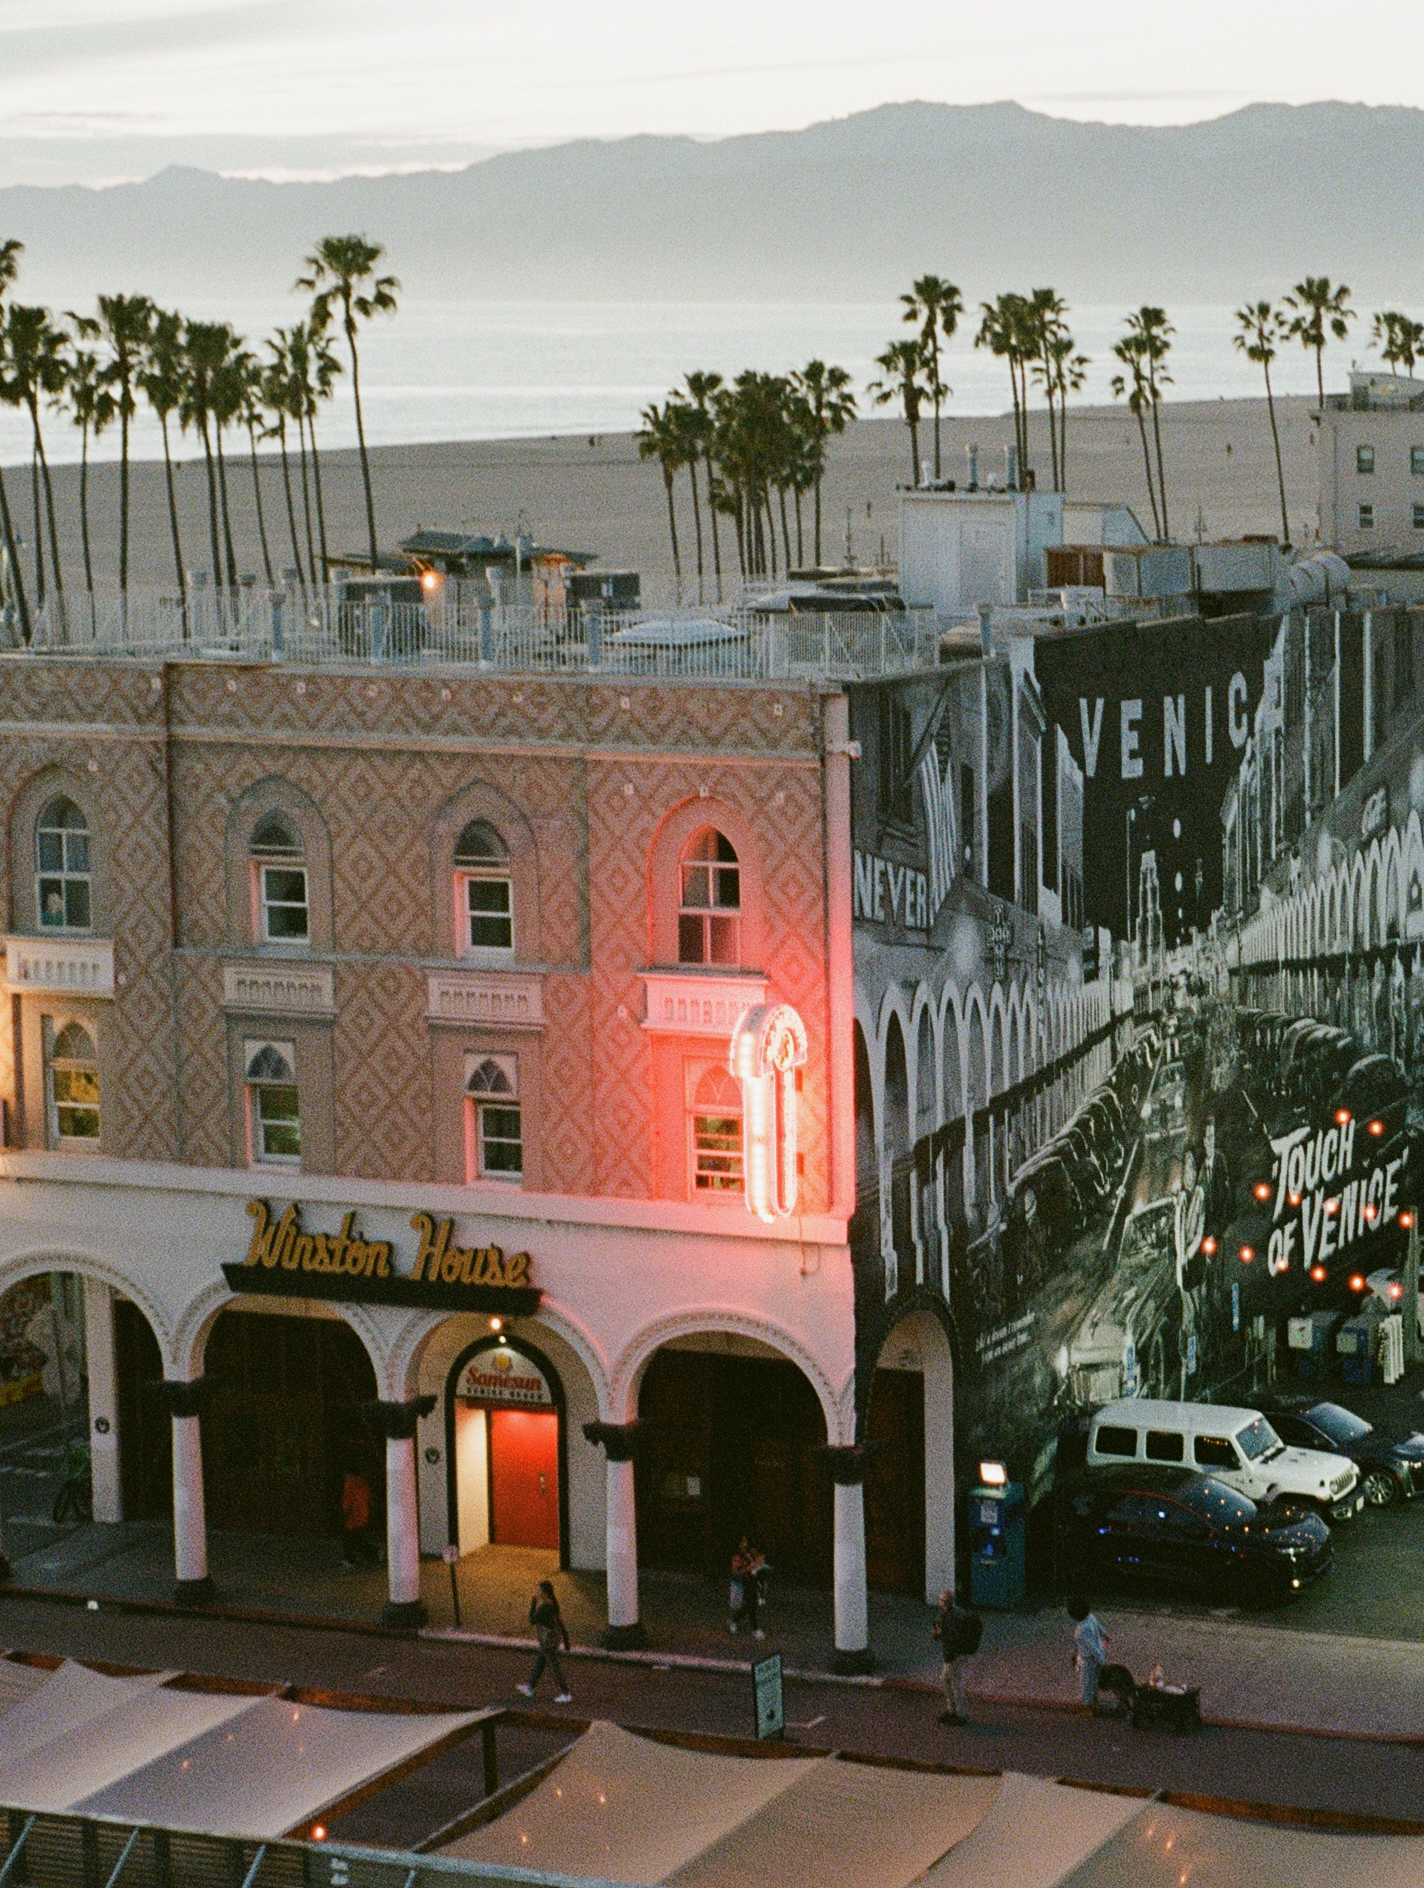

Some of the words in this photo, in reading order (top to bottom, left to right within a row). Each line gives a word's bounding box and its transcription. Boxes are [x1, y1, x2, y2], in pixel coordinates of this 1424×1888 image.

[854, 849, 928, 929] NEVER
[243, 1200, 394, 1278] Winston
[408, 1212, 532, 1289] House
[1267, 1218, 1298, 1278] OF
